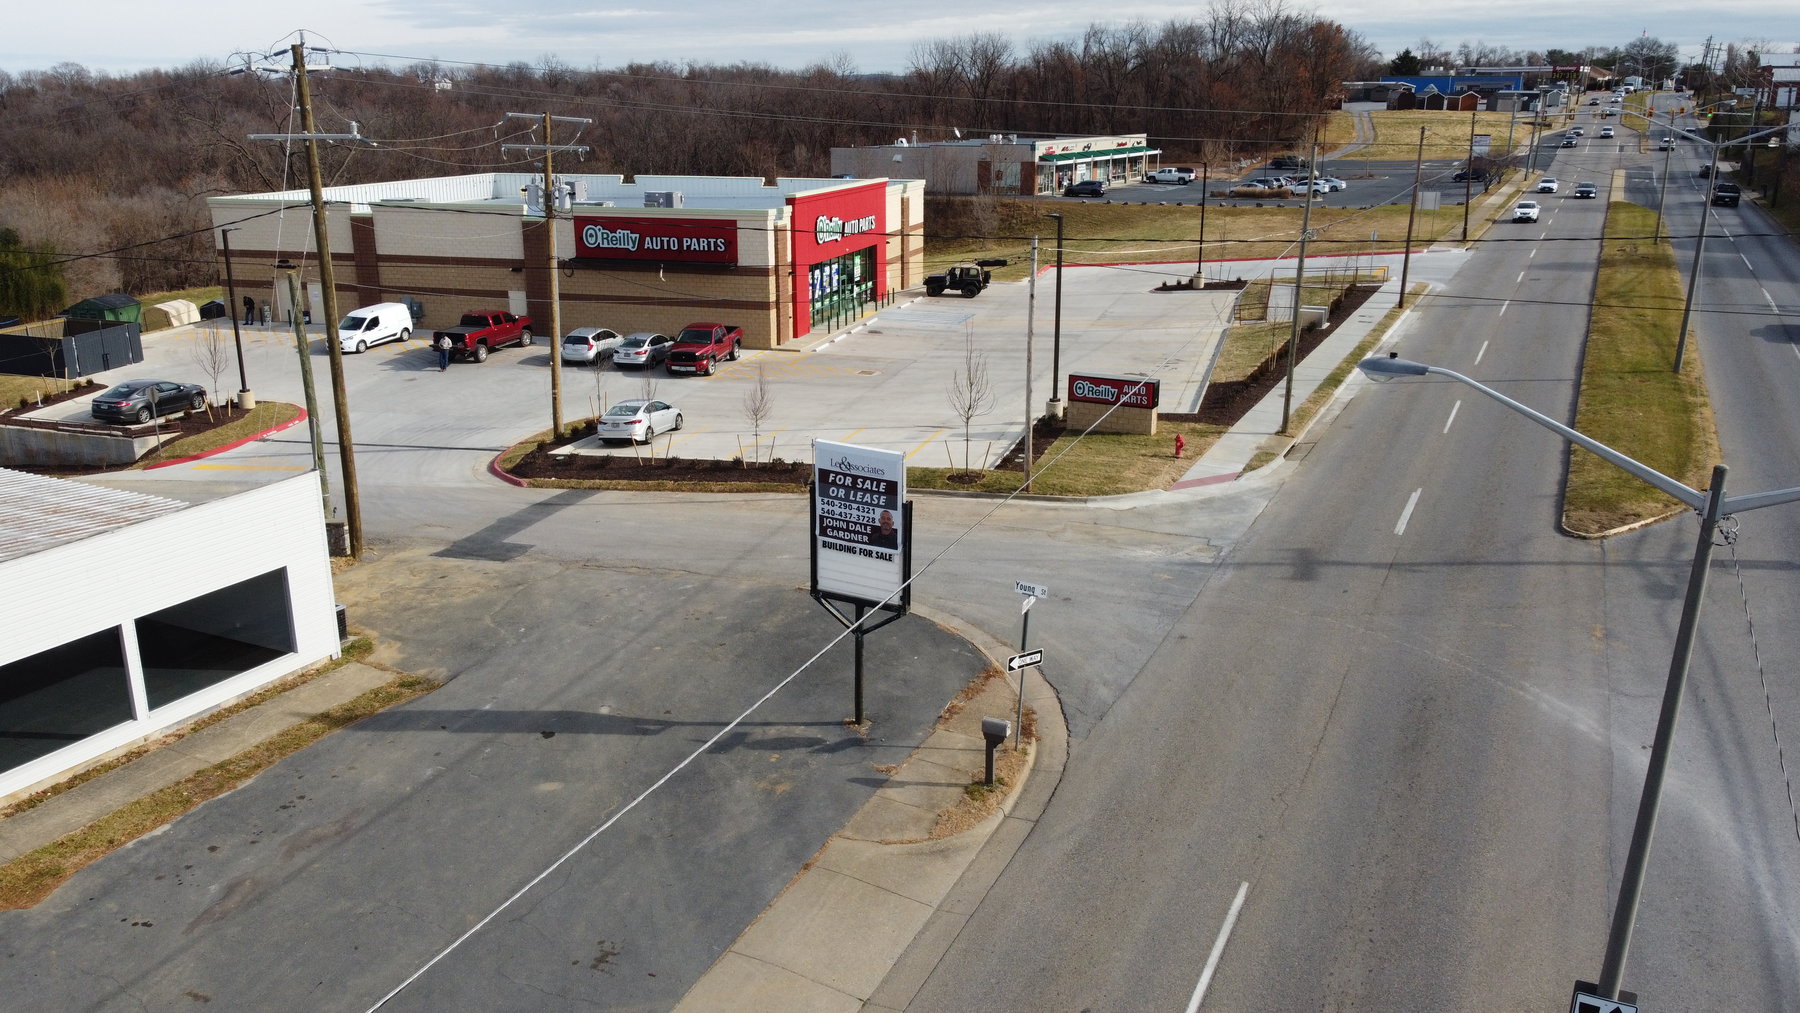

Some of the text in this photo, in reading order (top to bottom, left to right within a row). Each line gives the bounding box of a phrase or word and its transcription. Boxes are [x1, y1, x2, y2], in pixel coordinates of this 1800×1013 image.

[844, 219, 859, 237] AUTO
[859, 215, 876, 233] PARTS
[583, 225, 726, 252] O'Reilly AUTO PARTS
[1073, 380, 1146, 401] O'Reilly AUTO
[1120, 394, 1148, 405] PARTS
[828, 473, 887, 492] FOR SALE
[829, 487, 887, 506] OR LEASE
[820, 498, 876, 515] 540-290-4321
[820, 507, 876, 524] 540-437-3728
[822, 517, 872, 534] JOHN DALE
[826, 528, 869, 543] GARDNER
[822, 540, 893, 562] BUILDING FOR SALE
[1015, 581, 1036, 595] Young
